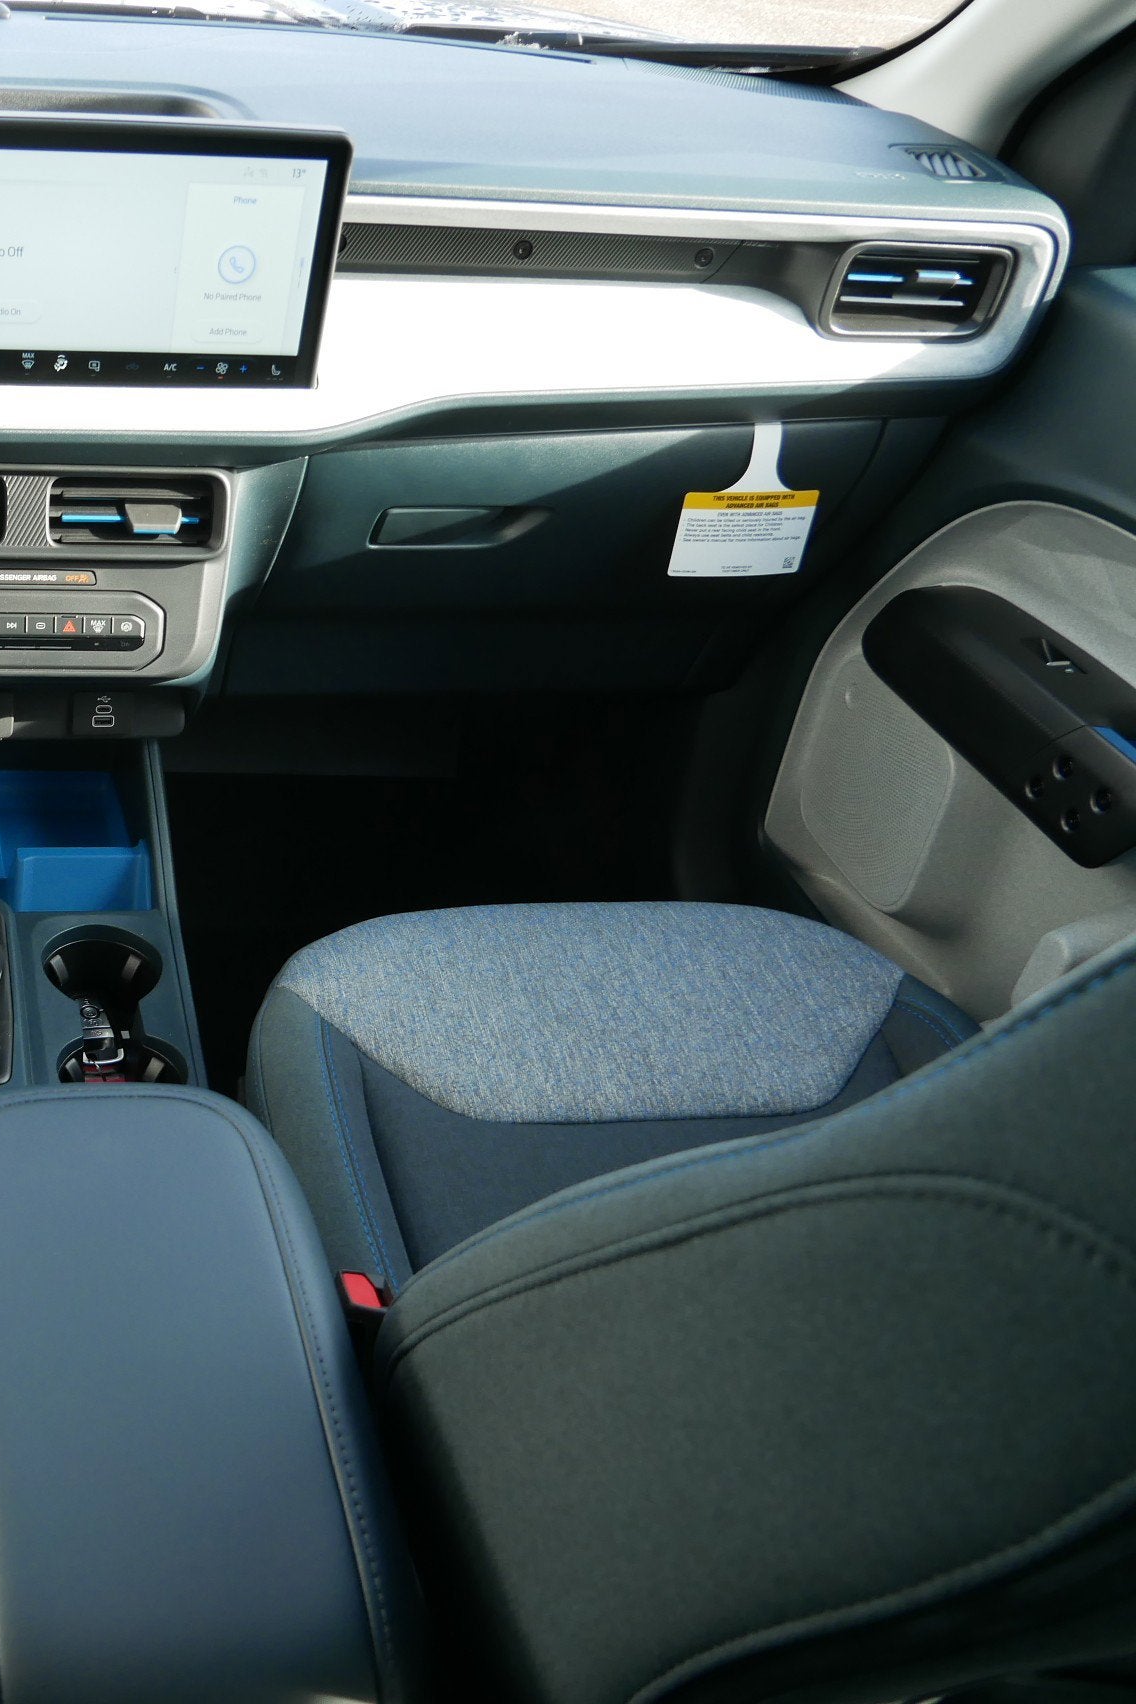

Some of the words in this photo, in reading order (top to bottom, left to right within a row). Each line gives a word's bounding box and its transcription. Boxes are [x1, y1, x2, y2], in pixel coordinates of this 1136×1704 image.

[233, 196, 257, 204] Phone
[7, 246, 24, 258] Off
[204, 292, 214, 300] No
[215, 293, 238, 301] Paired
[239, 293, 262, 302] Phone
[10, 308, 21, 316] On
[209, 328, 224, 336] Add
[224, 328, 247, 336] Phone
[164, 363, 178, 371] A/C
